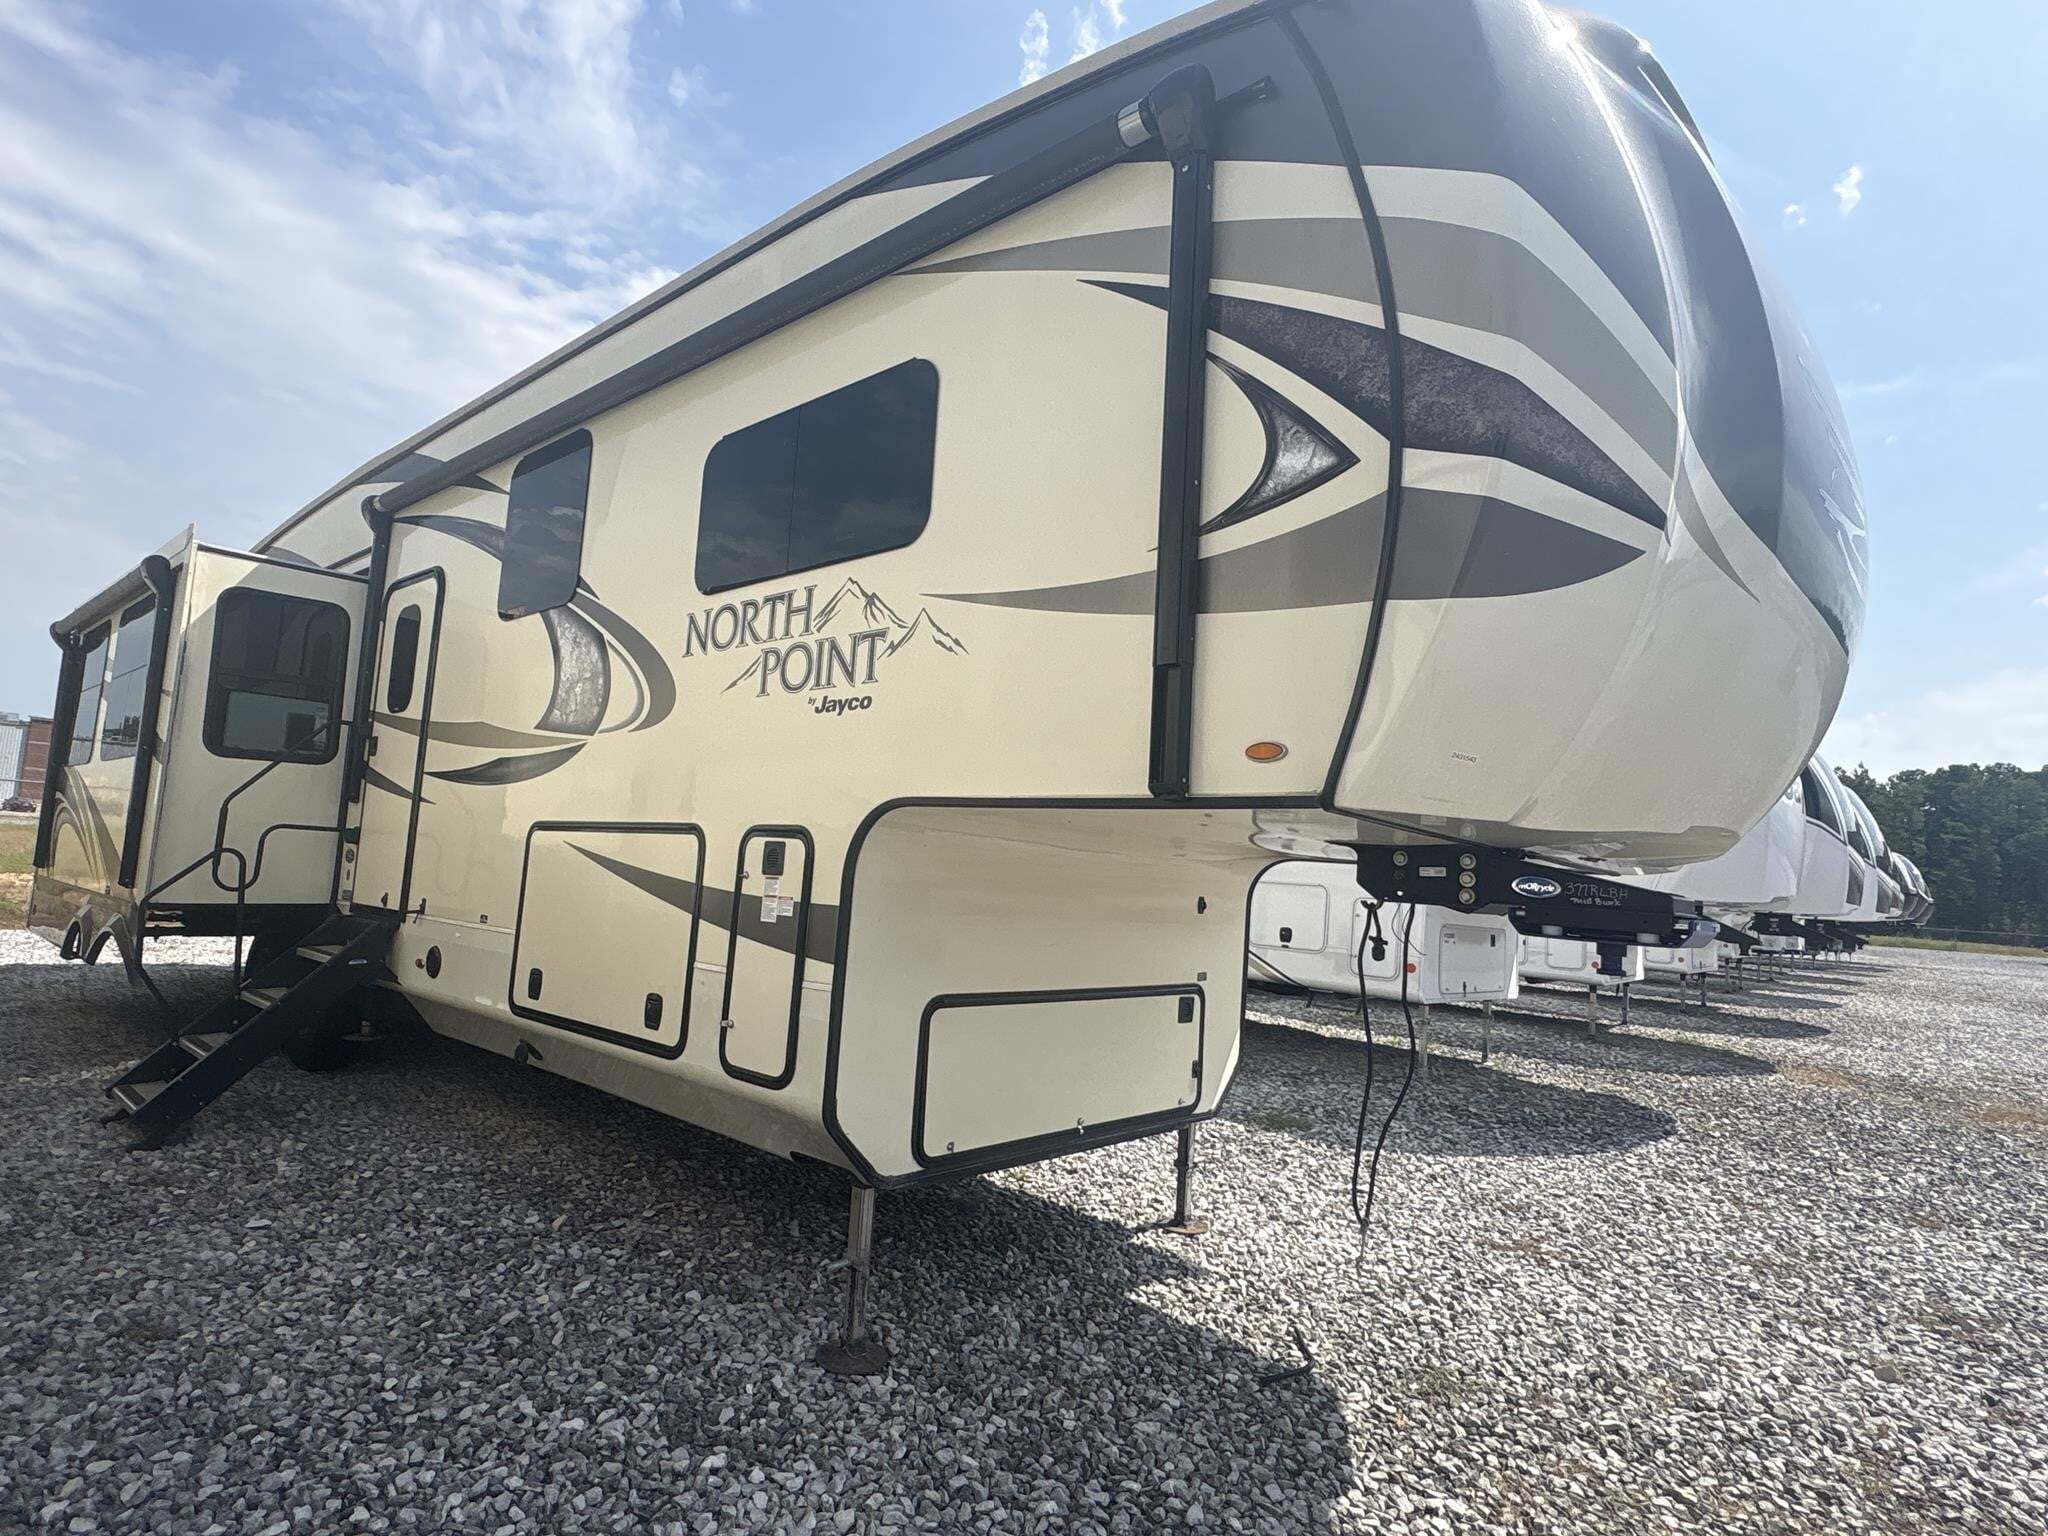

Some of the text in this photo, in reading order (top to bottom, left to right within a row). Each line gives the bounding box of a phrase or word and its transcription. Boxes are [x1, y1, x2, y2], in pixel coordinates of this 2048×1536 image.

[681, 584, 818, 658] NORTH
[755, 627, 890, 698] POINT
[808, 695, 873, 716] by Jayco
